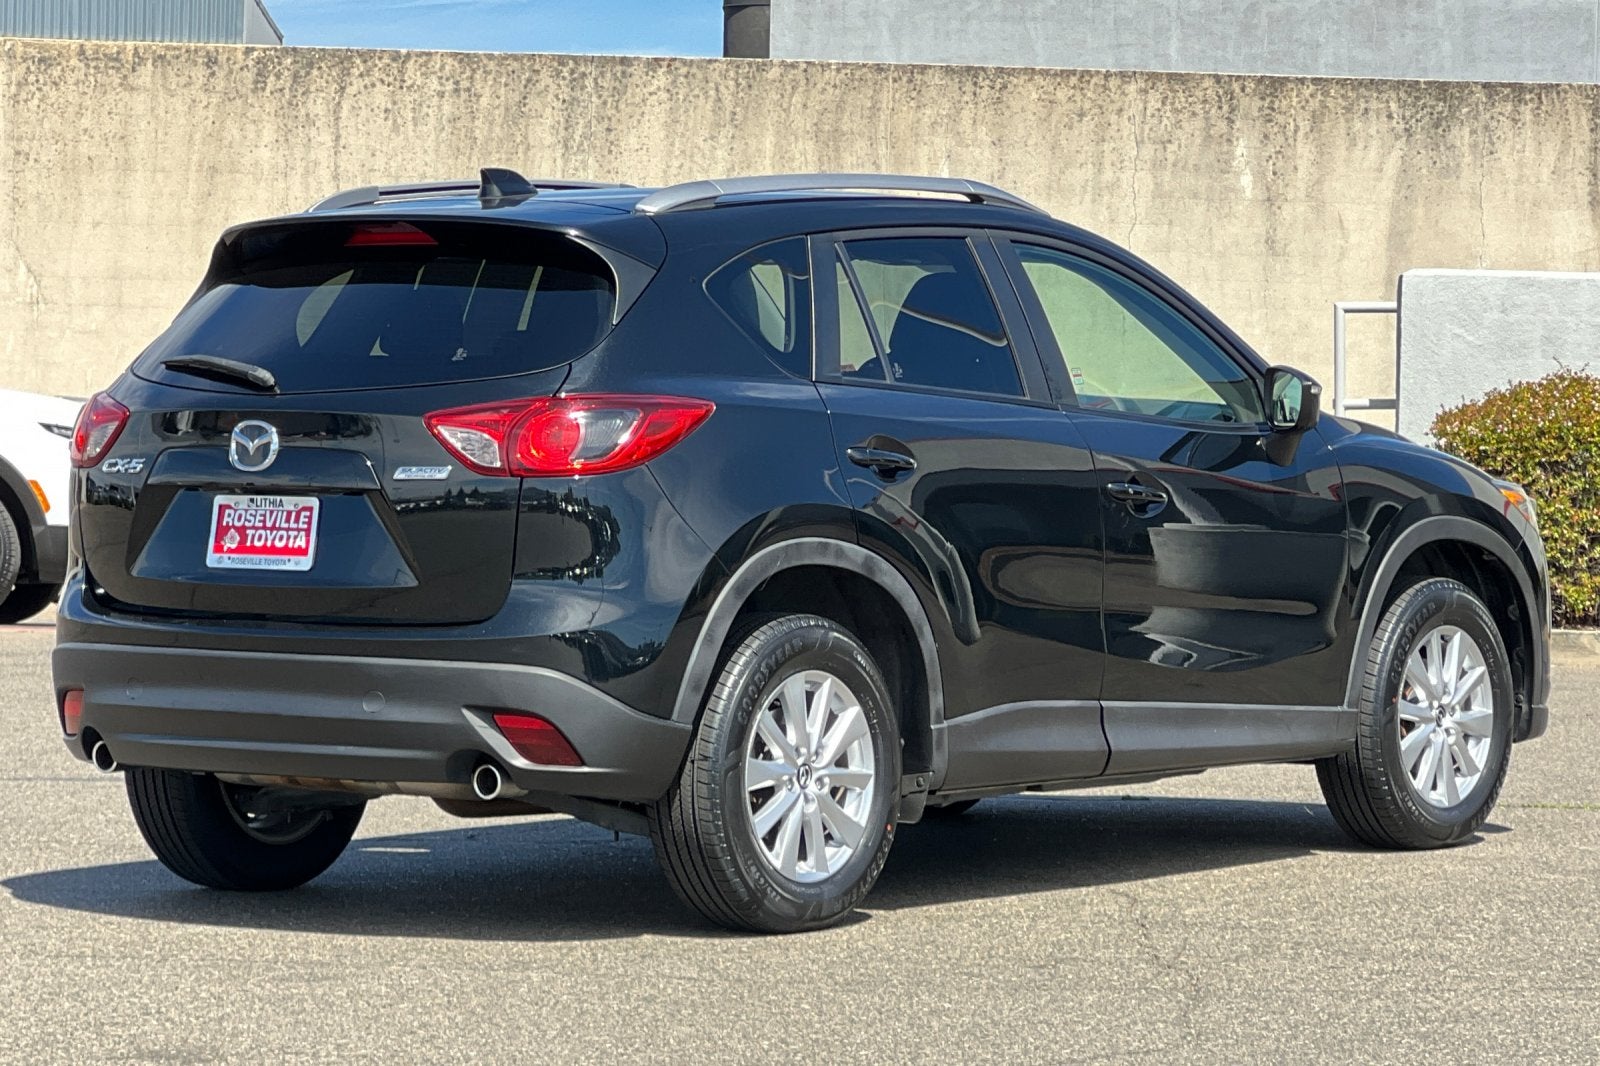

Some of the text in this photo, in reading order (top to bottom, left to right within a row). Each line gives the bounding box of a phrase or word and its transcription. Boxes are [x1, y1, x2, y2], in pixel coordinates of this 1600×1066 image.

[102, 458, 145, 473] CX-5
[255, 498, 284, 508] LITHIA
[222, 509, 310, 529] ROSEVILLE
[245, 529, 306, 549] TOYOTA
[231, 558, 262, 566] ROSEVILLE
[738, 638, 803, 724] GOODYEAR
